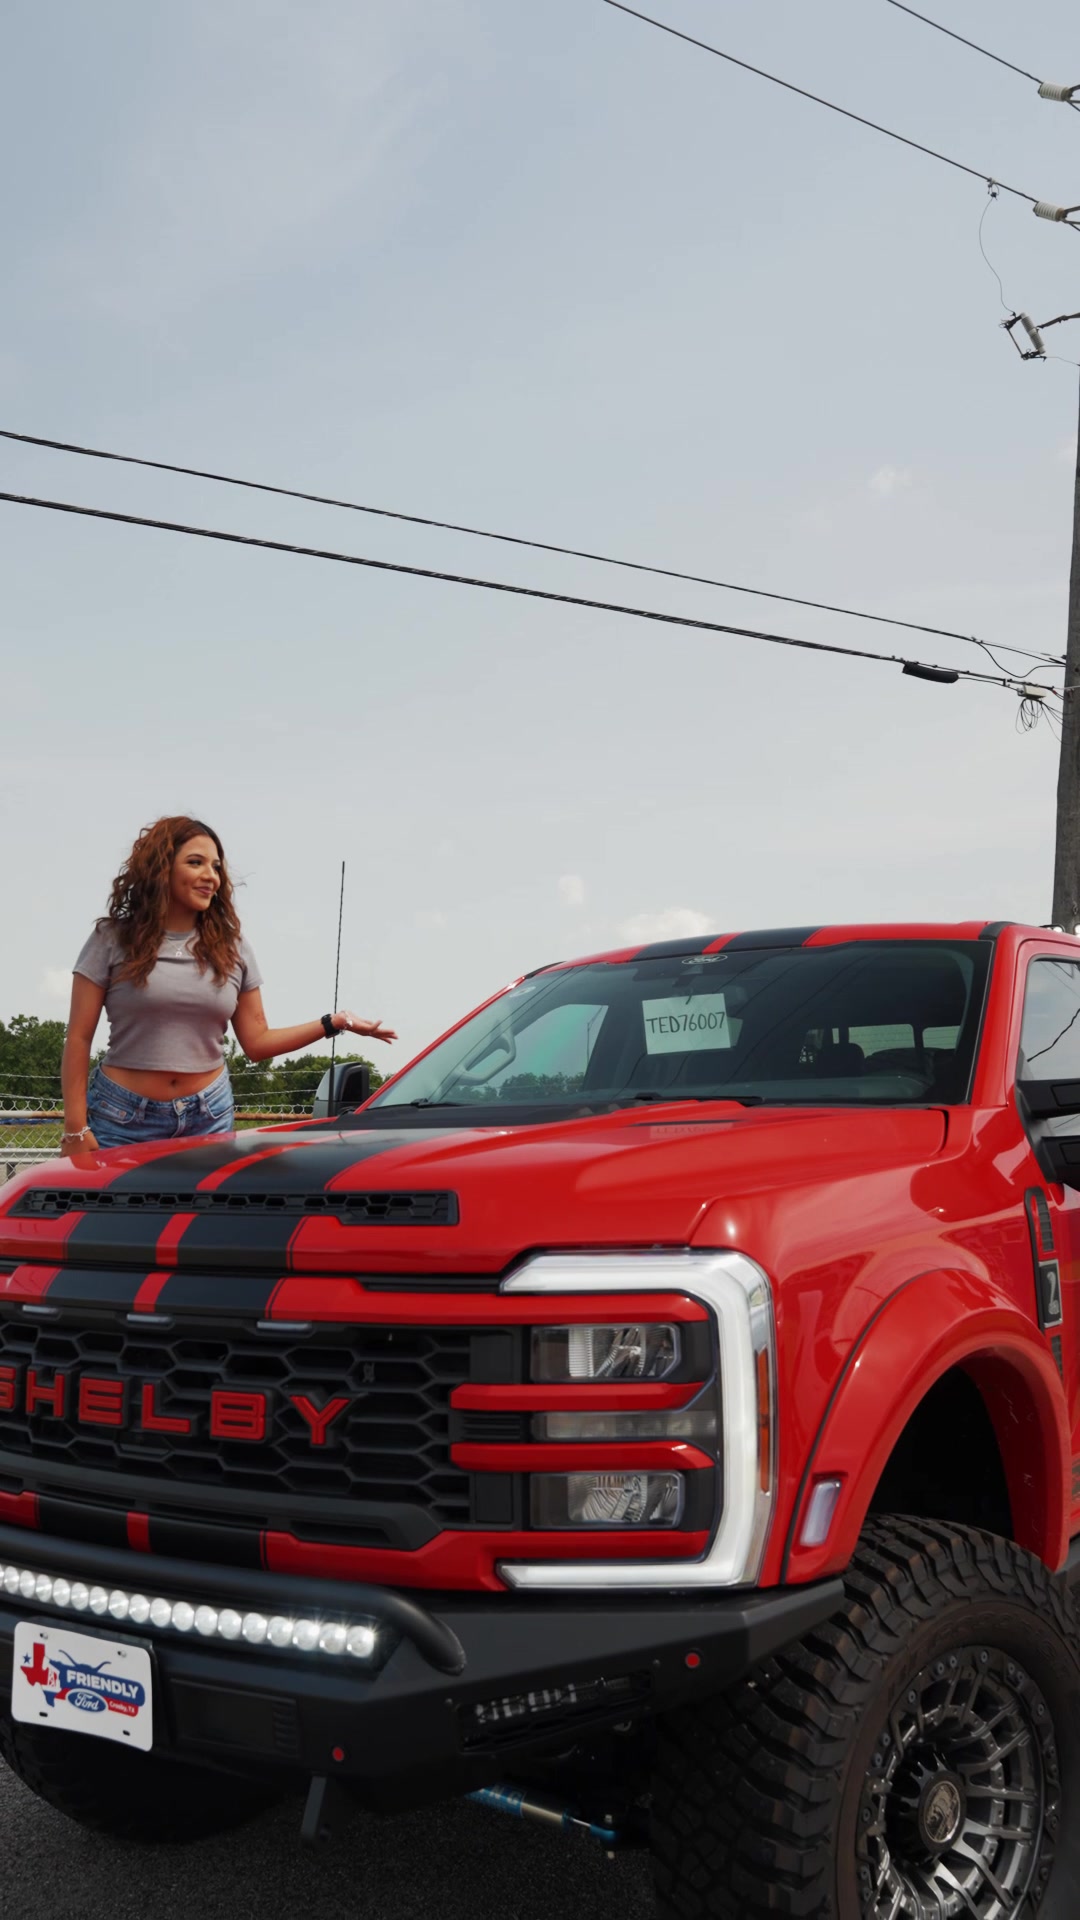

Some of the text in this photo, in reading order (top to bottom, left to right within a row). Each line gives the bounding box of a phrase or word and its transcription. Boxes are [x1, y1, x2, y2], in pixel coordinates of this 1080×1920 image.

[645, 1011, 726, 1034] TED76007
[66, 1669, 139, 1699] FRIENDLY
[74, 1692, 99, 1711] Ford
